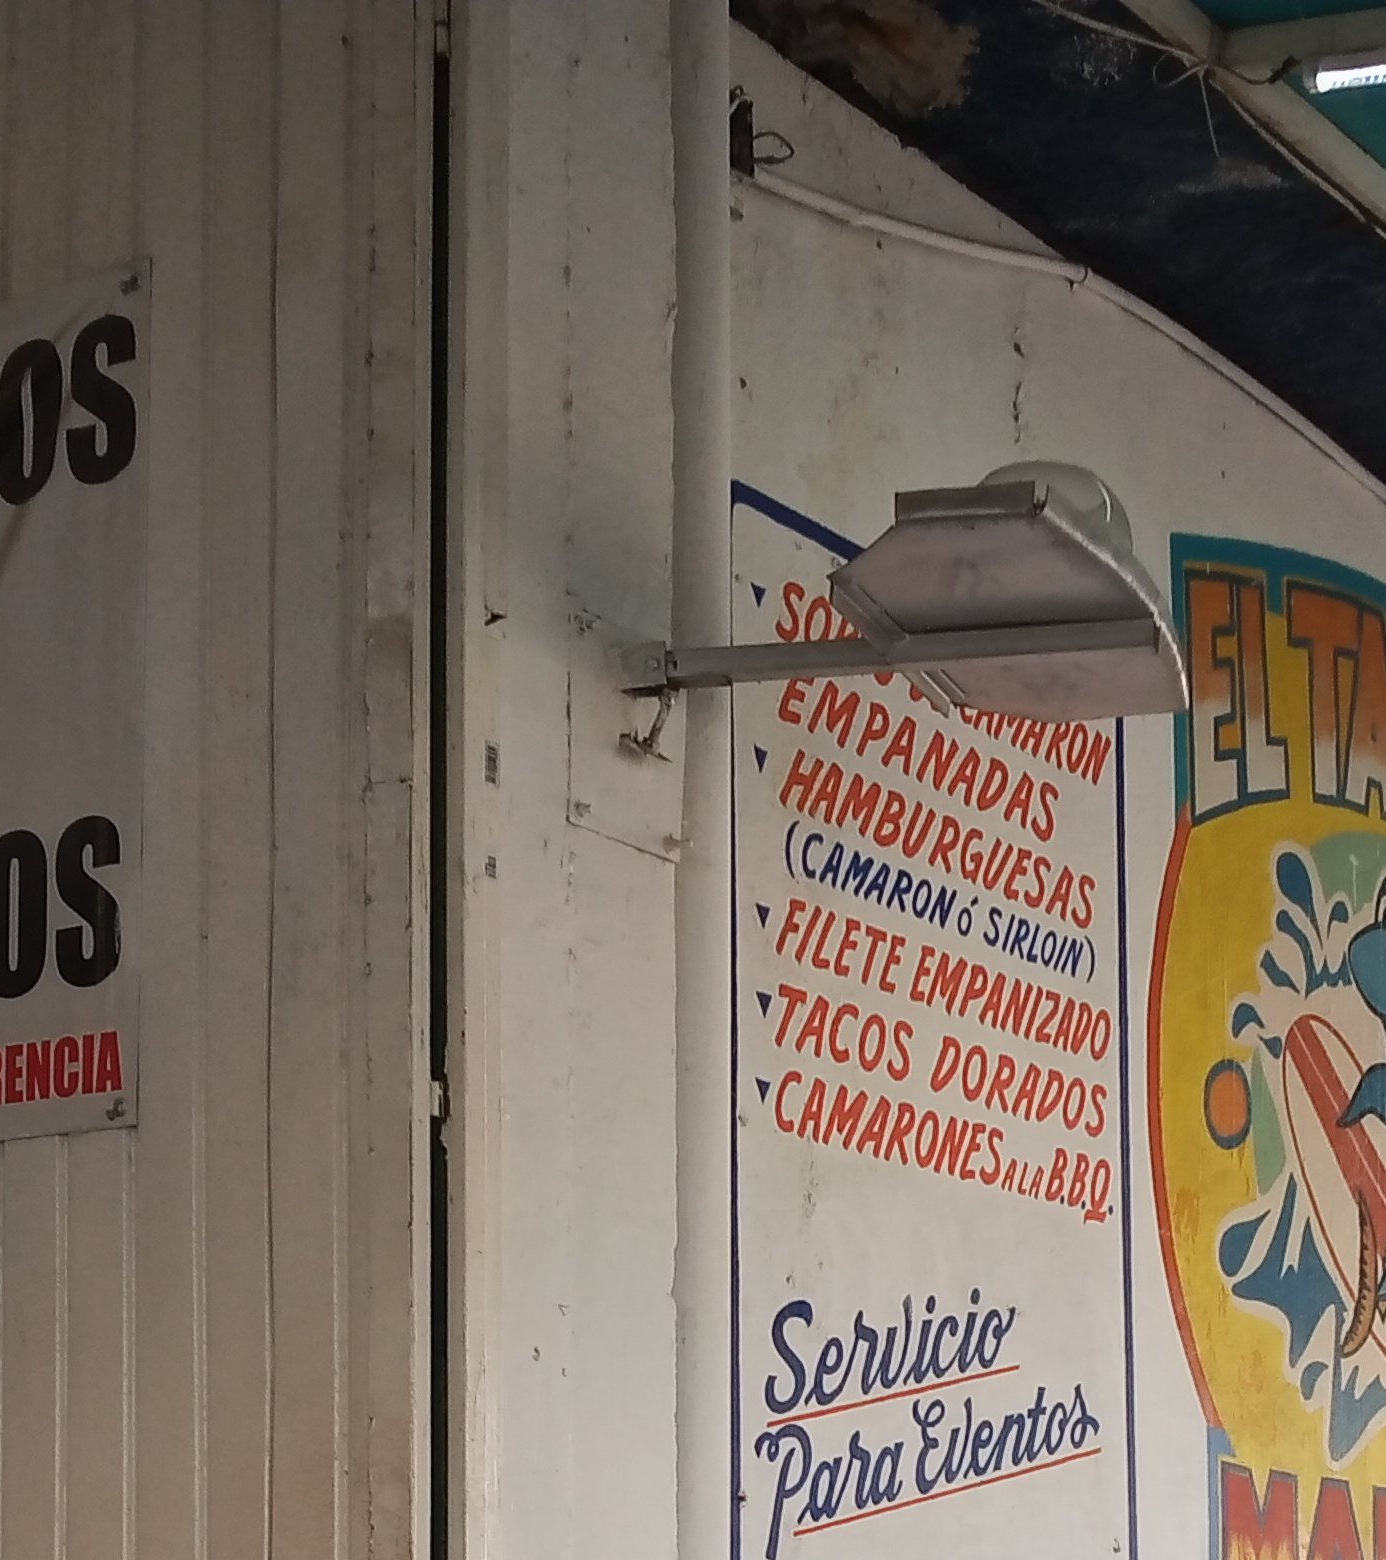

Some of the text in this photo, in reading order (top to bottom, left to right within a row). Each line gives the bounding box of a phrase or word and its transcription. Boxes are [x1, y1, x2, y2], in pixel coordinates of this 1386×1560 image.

[777, 677, 1060, 842] EMPANADAS
[1186, 568, 1290, 826] EL
[778, 749, 1097, 929] HAMBURGUESAS
[785, 820, 959, 932] (CAMARON
[983, 906, 1096, 983] SIRLOIN)
[775, 899, 1113, 1060] FILETE EMPANIZADO
[774, 983, 1108, 1138] TACOS DORADOS
[774, 1070, 1004, 1185] CAMARONES
[764, 1288, 1016, 1415] Servicio
[912, 1384, 1100, 1495] Eventos
